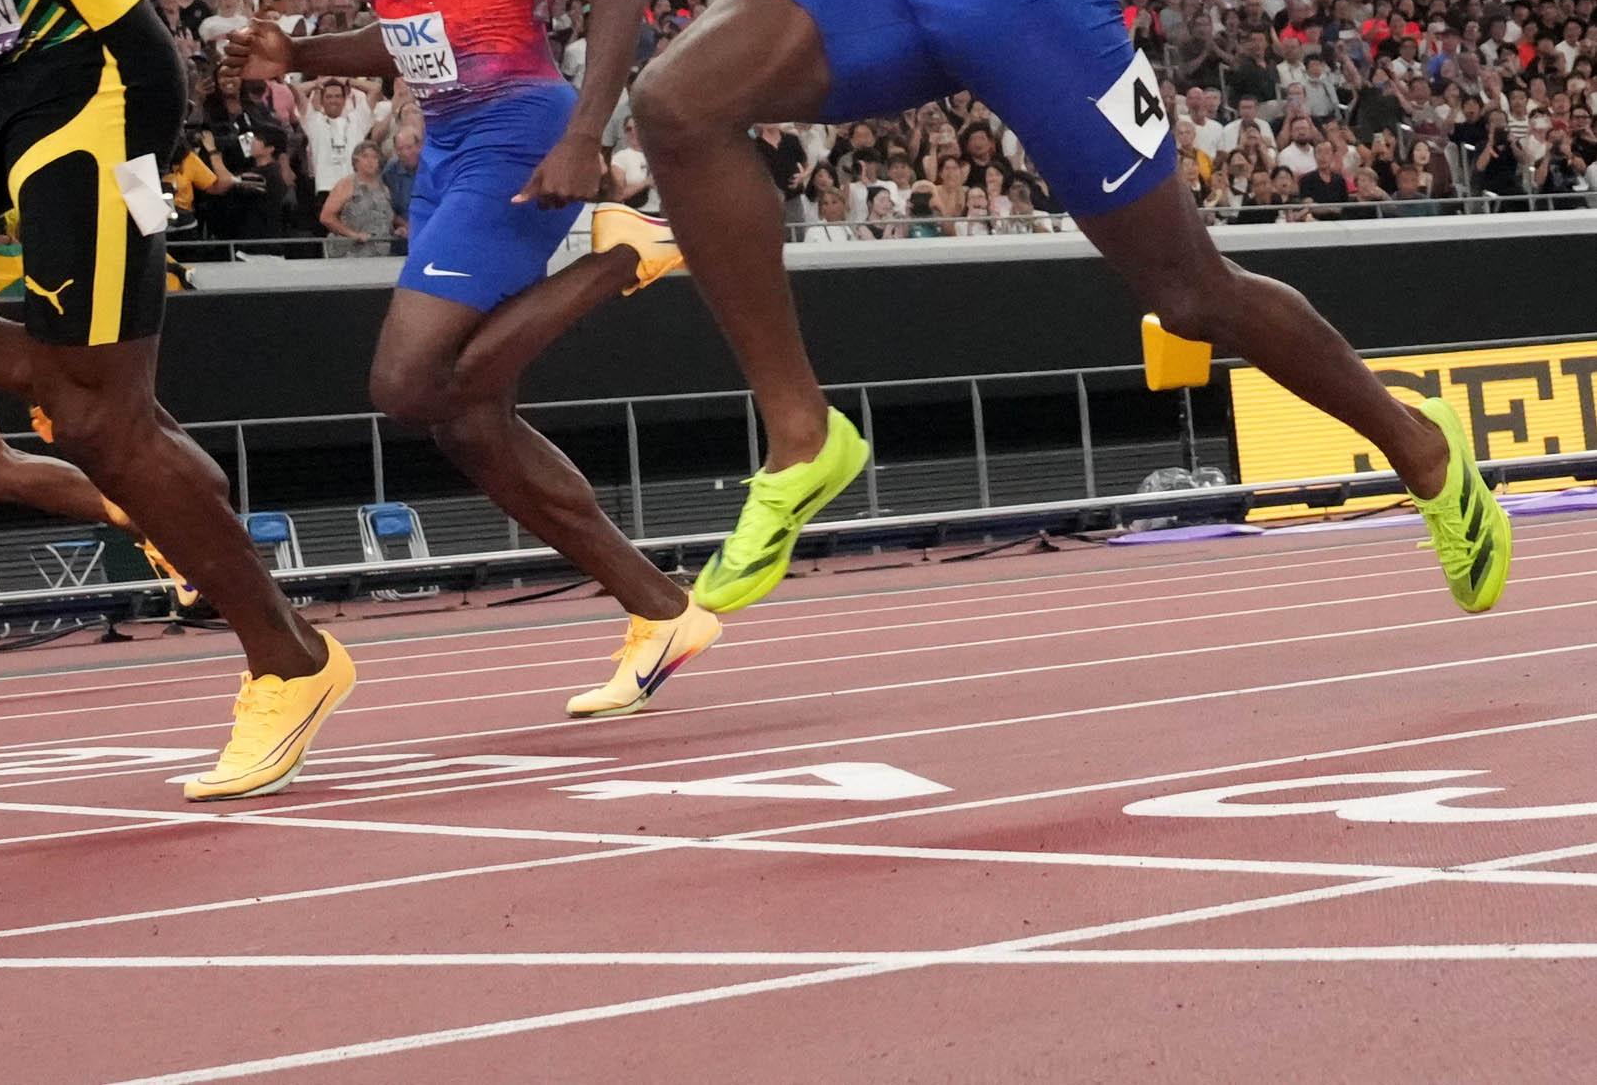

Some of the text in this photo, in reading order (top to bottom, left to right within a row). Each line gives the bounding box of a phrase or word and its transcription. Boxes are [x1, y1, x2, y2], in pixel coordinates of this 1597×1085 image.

[381, 18, 438, 47] TDK
[1134, 77, 1164, 127] 4
[548, 762, 954, 801] 4
